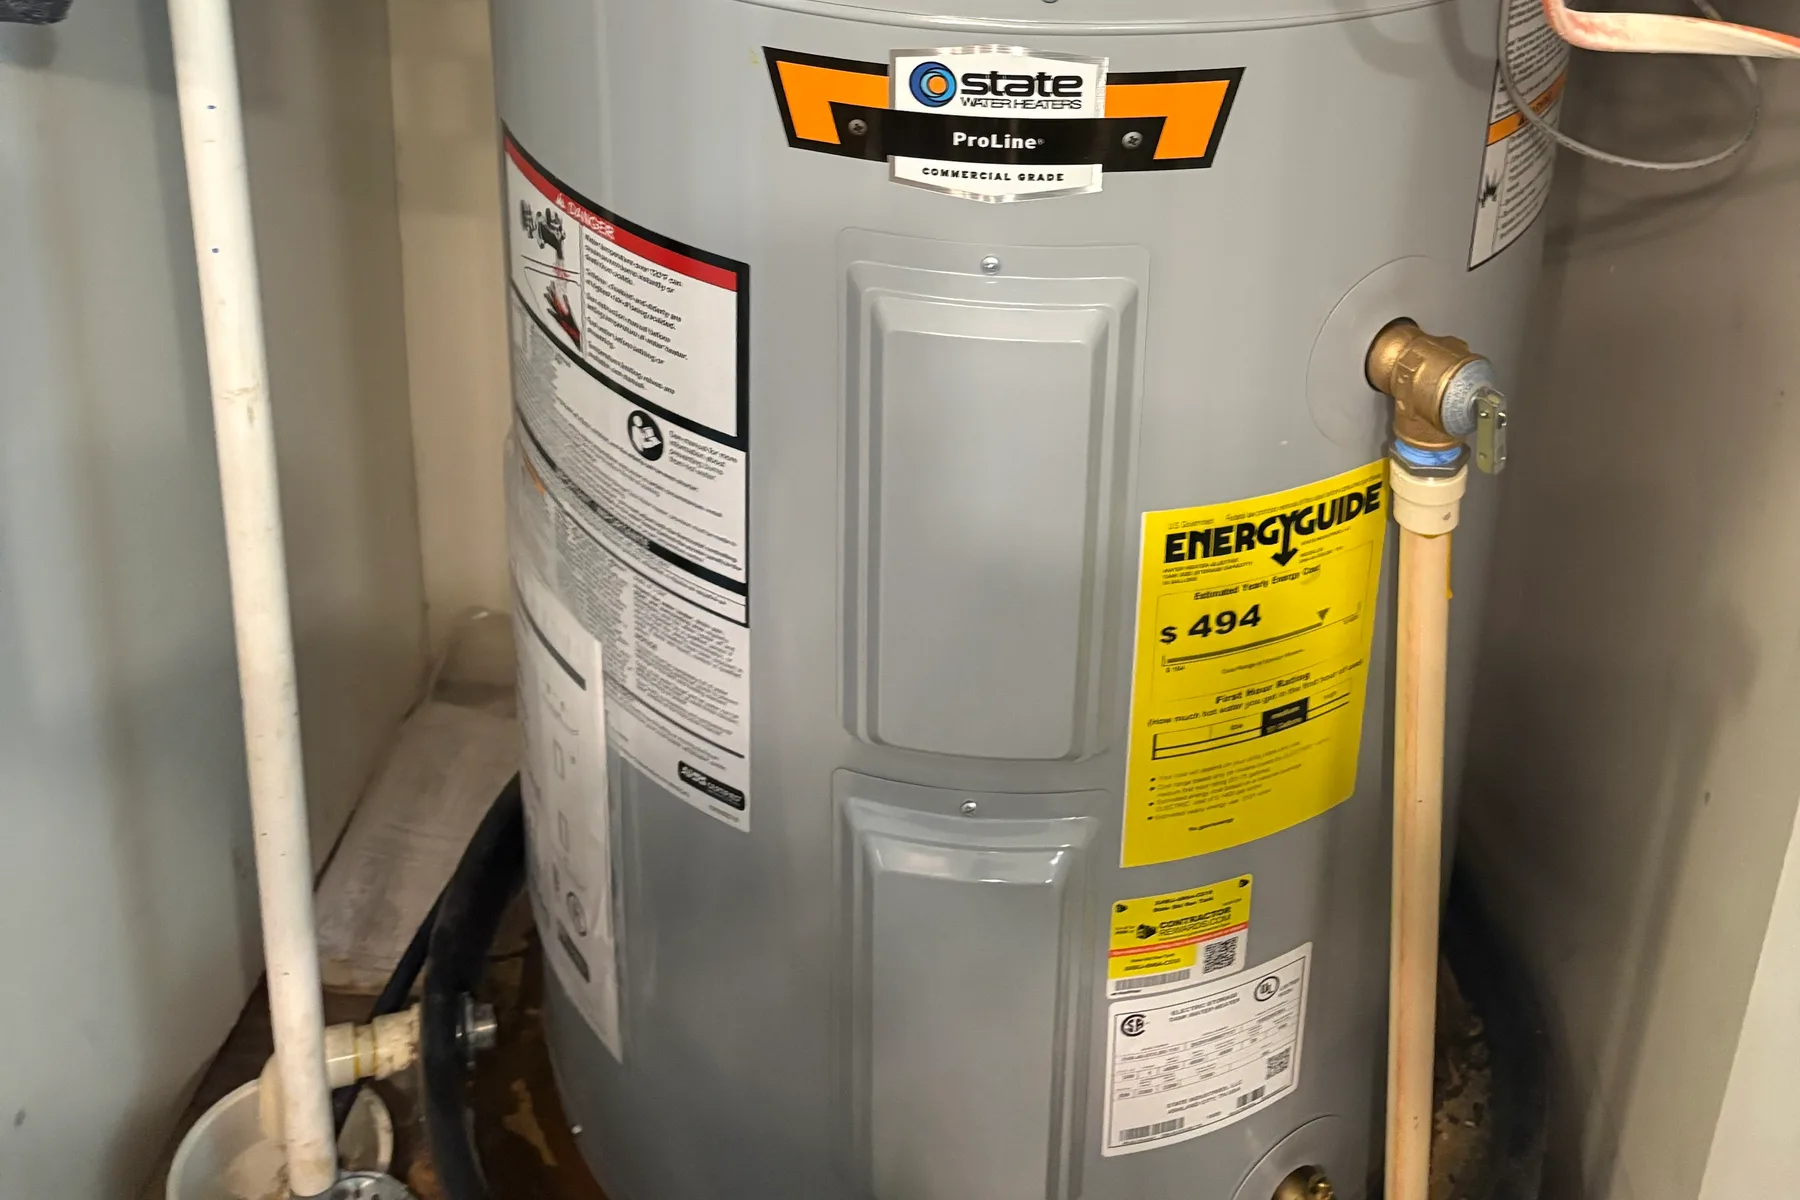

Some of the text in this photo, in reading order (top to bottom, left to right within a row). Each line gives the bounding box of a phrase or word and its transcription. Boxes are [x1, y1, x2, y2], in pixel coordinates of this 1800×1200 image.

[960, 71, 1084, 97] state
[960, 97, 1083, 110] WATER HEATERS
[922, 167, 1065, 182] COMMERCIAL GRADE
[567, 201, 616, 240] DANGER
[1159, 604, 1262, 645] $ 494
[1160, 907, 1232, 928] CONTRACTOR
